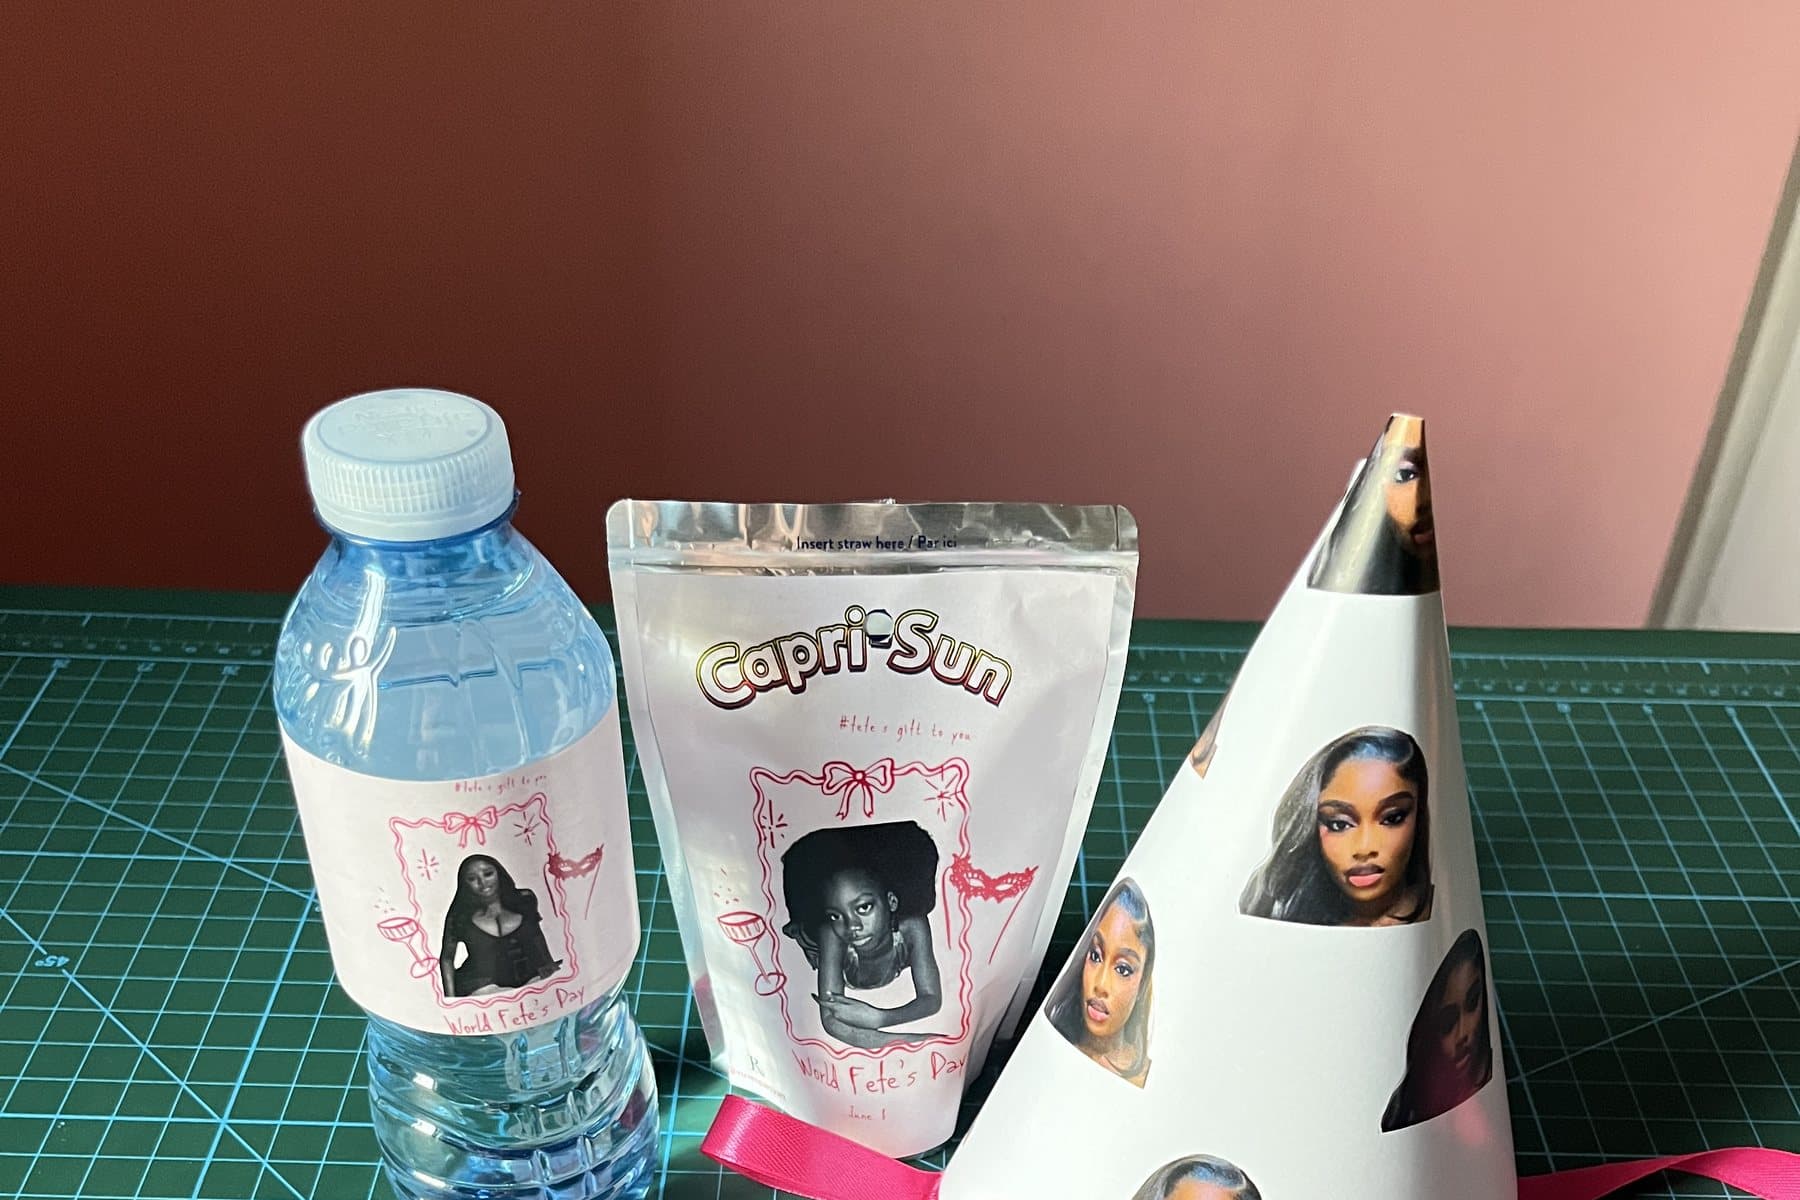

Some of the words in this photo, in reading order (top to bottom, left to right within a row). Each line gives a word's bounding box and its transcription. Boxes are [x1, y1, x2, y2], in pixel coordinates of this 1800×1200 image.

[797, 536, 833, 550] Insert
[838, 538, 872, 550] straw
[875, 536, 904, 550] here
[918, 535, 939, 549] Par
[943, 535, 957, 548] ici
[897, 719, 921, 742] gift
[932, 724, 943, 737] to
[952, 731, 971, 745] you
[444, 1012, 493, 1034] World
[498, 999, 549, 1030] Fete's
[556, 985, 585, 1008] Day
[792, 1049, 840, 1092] World
[849, 1059, 917, 1095] Fete's
[930, 1051, 967, 1080] Day
